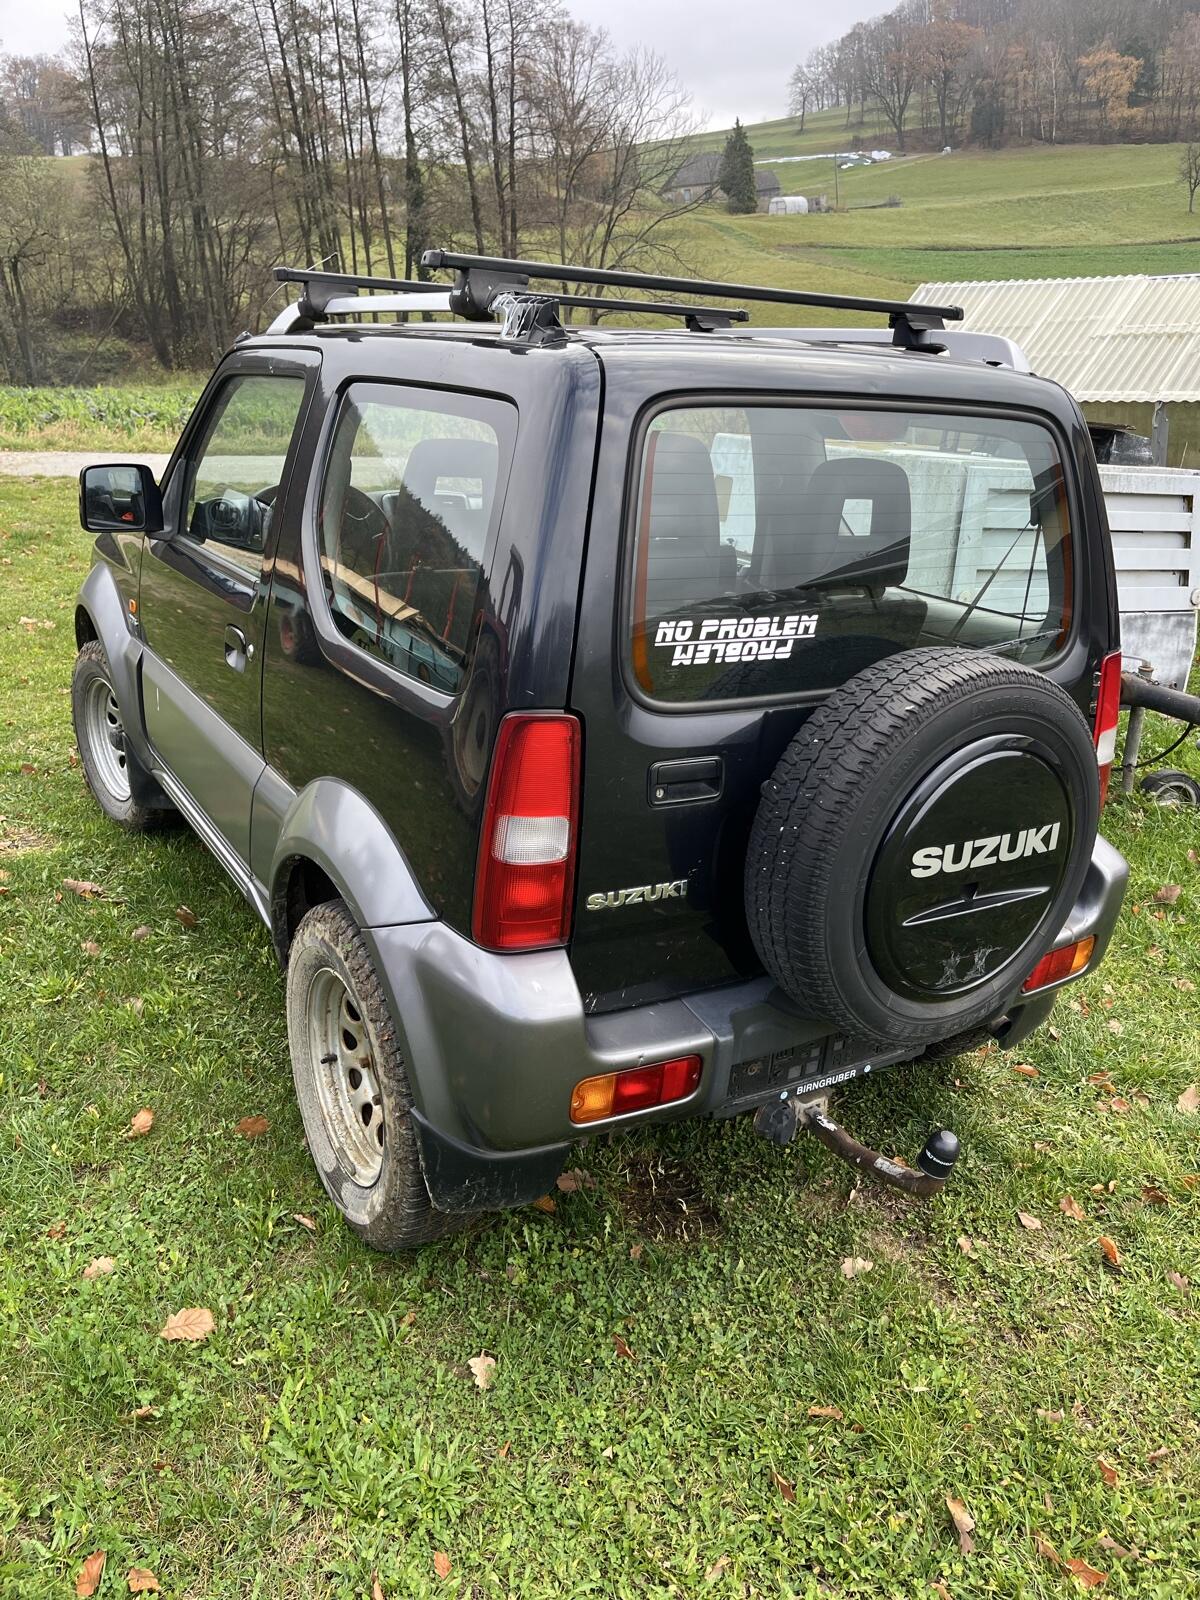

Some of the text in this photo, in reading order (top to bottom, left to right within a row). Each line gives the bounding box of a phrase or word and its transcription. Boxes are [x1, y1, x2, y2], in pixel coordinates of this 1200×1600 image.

[655, 614, 819, 643] NO PROBLEM
[671, 638, 794, 666] PROBLEM
[910, 822, 1061, 878] SUZUKI
[586, 879, 688, 911] SUZUKI
[796, 1069, 857, 1095] BIRNGRUBER
